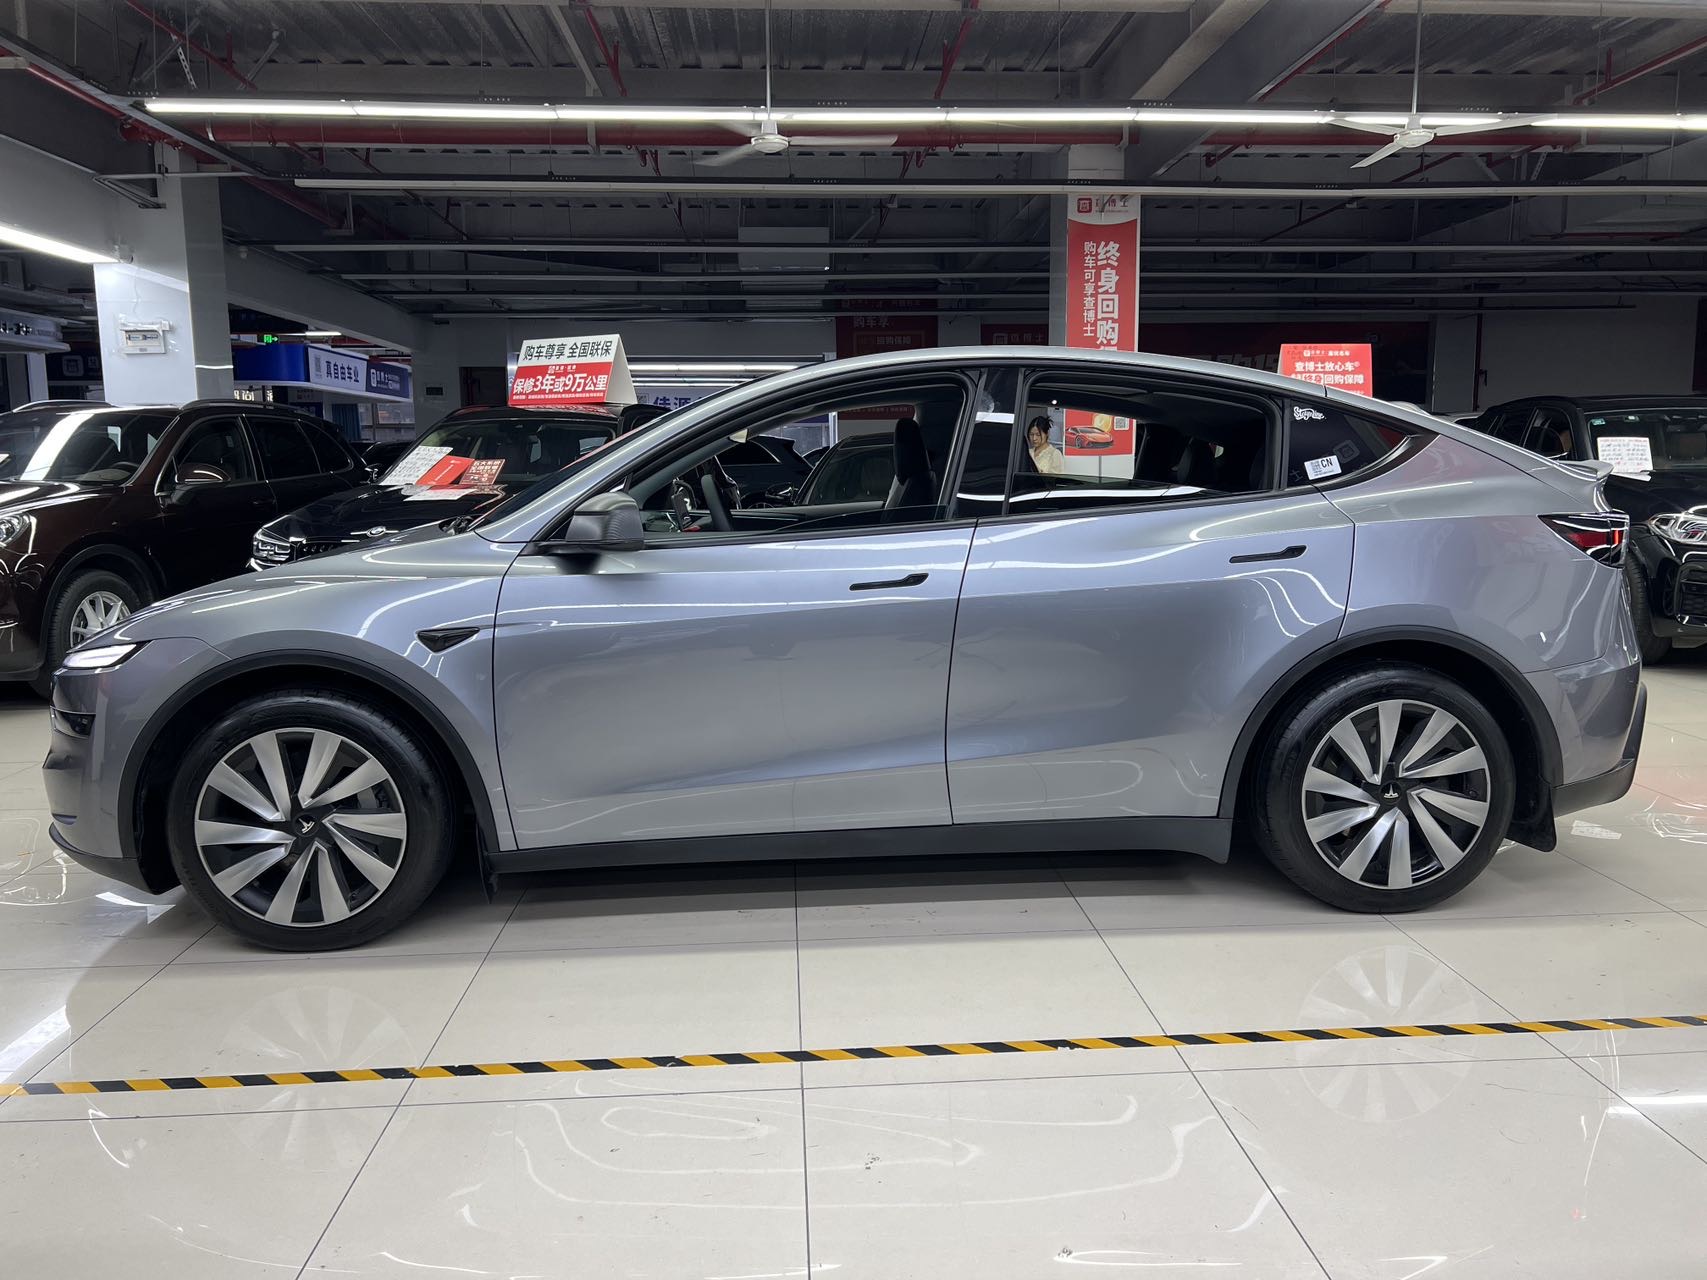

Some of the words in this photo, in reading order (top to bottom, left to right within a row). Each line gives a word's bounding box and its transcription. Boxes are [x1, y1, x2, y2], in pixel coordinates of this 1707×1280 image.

[1083, 241, 1096, 337] 购车可享查博士
[1096, 241, 1120, 351] 终身回购
[523, 343, 567, 360] 购车尊享
[567, 340, 612, 358] 全国联保
[512, 373, 609, 393] 保修3年或9万公里
[1321, 457, 1334, 468] CN
